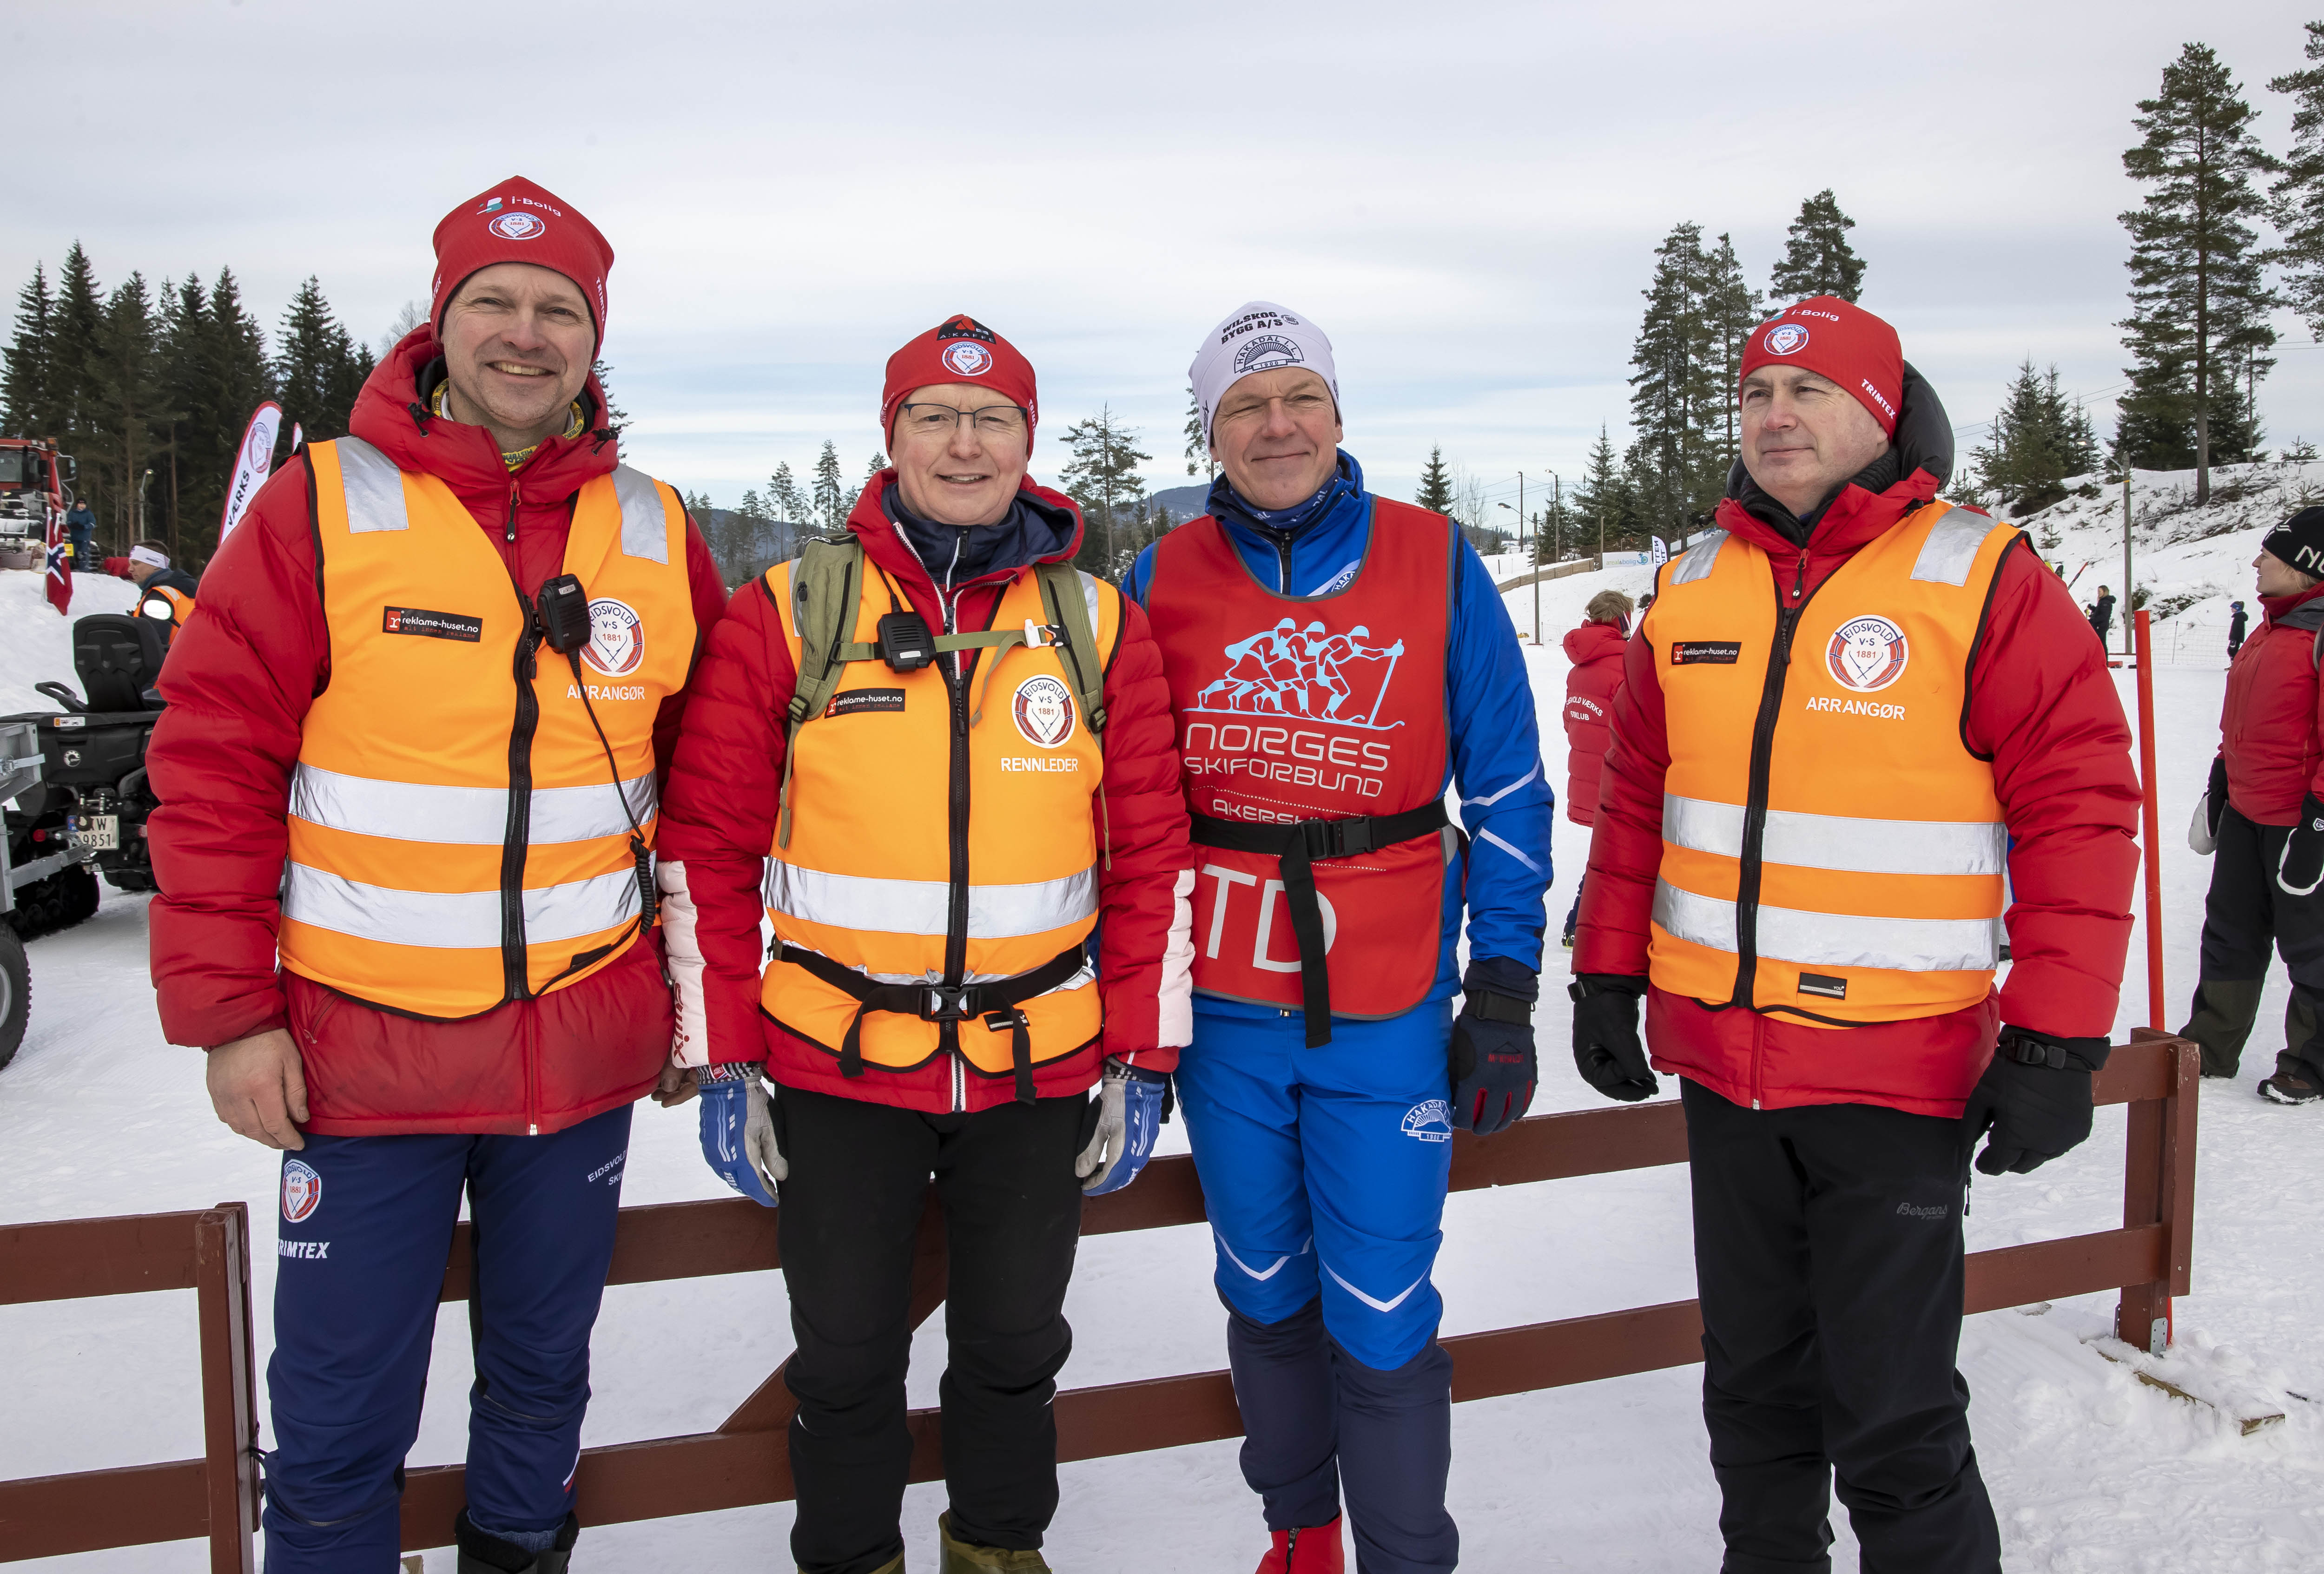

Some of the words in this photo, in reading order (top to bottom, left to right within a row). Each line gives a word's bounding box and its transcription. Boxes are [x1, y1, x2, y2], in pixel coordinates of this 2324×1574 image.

[512, 196, 561, 217] i-Bolig
[1223, 311, 1278, 334] WILSKOG
[1791, 310, 1839, 321] i-Bolig
[1221, 323, 1253, 344] BYGG
[1257, 318, 1283, 329] A/S
[952, 344, 984, 353] EIDSVOLD
[1236, 336, 1279, 364] HAKADAL
[1861, 378, 1896, 420] TRIMTEX
[228, 470, 250, 525] VÆRKS
[403, 616, 478, 632] reklame-huset.no
[1844, 623, 1894, 641] EIDSVOLD
[567, 685, 645, 700] ARRANGØR
[837, 695, 902, 706] reklame-huset.no
[1024, 681, 1064, 701] EIDSVOLD
[1038, 707, 1055, 716] 1881
[1582, 698, 1603, 716] VÆRKS
[1805, 697, 1905, 720] ARRANGØR
[1186, 723, 1391, 771] NORGES
[1001, 758, 1078, 772] RENNLEDER
[1184, 757, 1383, 797] SKIFORBUND
[83, 834, 111, 847] 9851
[1202, 864, 1337, 973] TD
[285, 1165, 312, 1179] EIDSVOLD
[588, 1150, 626, 1182] EIDSVOLD
[1896, 1202, 1948, 1219] Bergans
